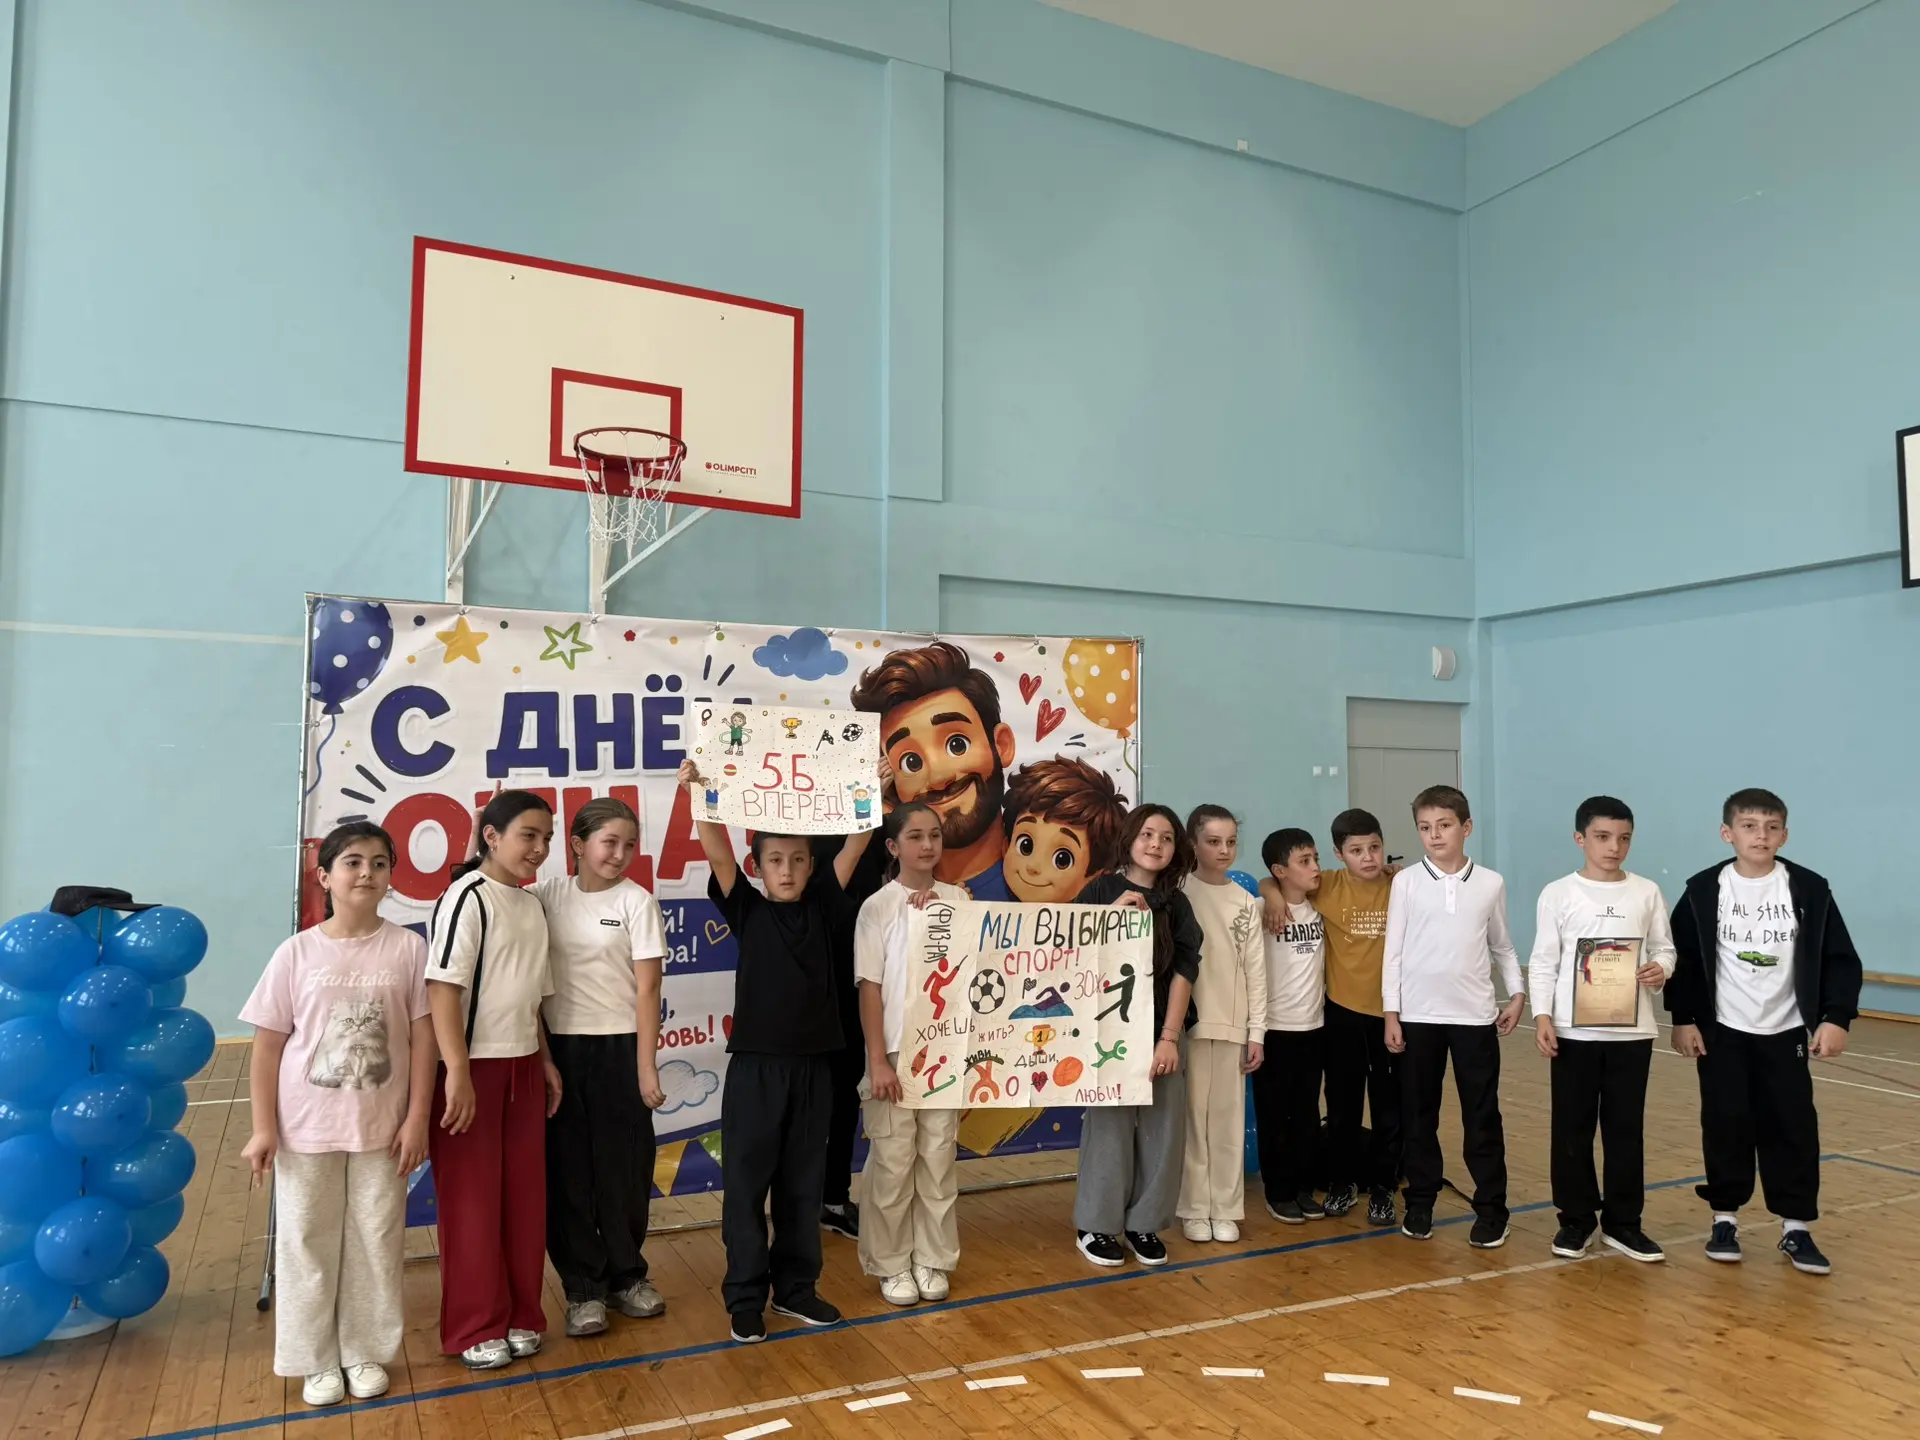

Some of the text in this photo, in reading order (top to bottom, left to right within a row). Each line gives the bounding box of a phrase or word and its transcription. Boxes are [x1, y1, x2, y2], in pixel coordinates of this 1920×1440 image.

[371, 674, 752, 778] С ДНЁ
[1606, 906, 1615, 915] R
[979, 907, 1151, 952] МЫ ВЫБИРАЕМ
[1763, 929, 1798, 944] DREA
[1003, 947, 1080, 976] СПОРТ!
[915, 1017, 1015, 1045] ХОЧЕШЬ ЖИТЬ?
[1075, 1083, 1122, 1103] ЛЮБИ!
